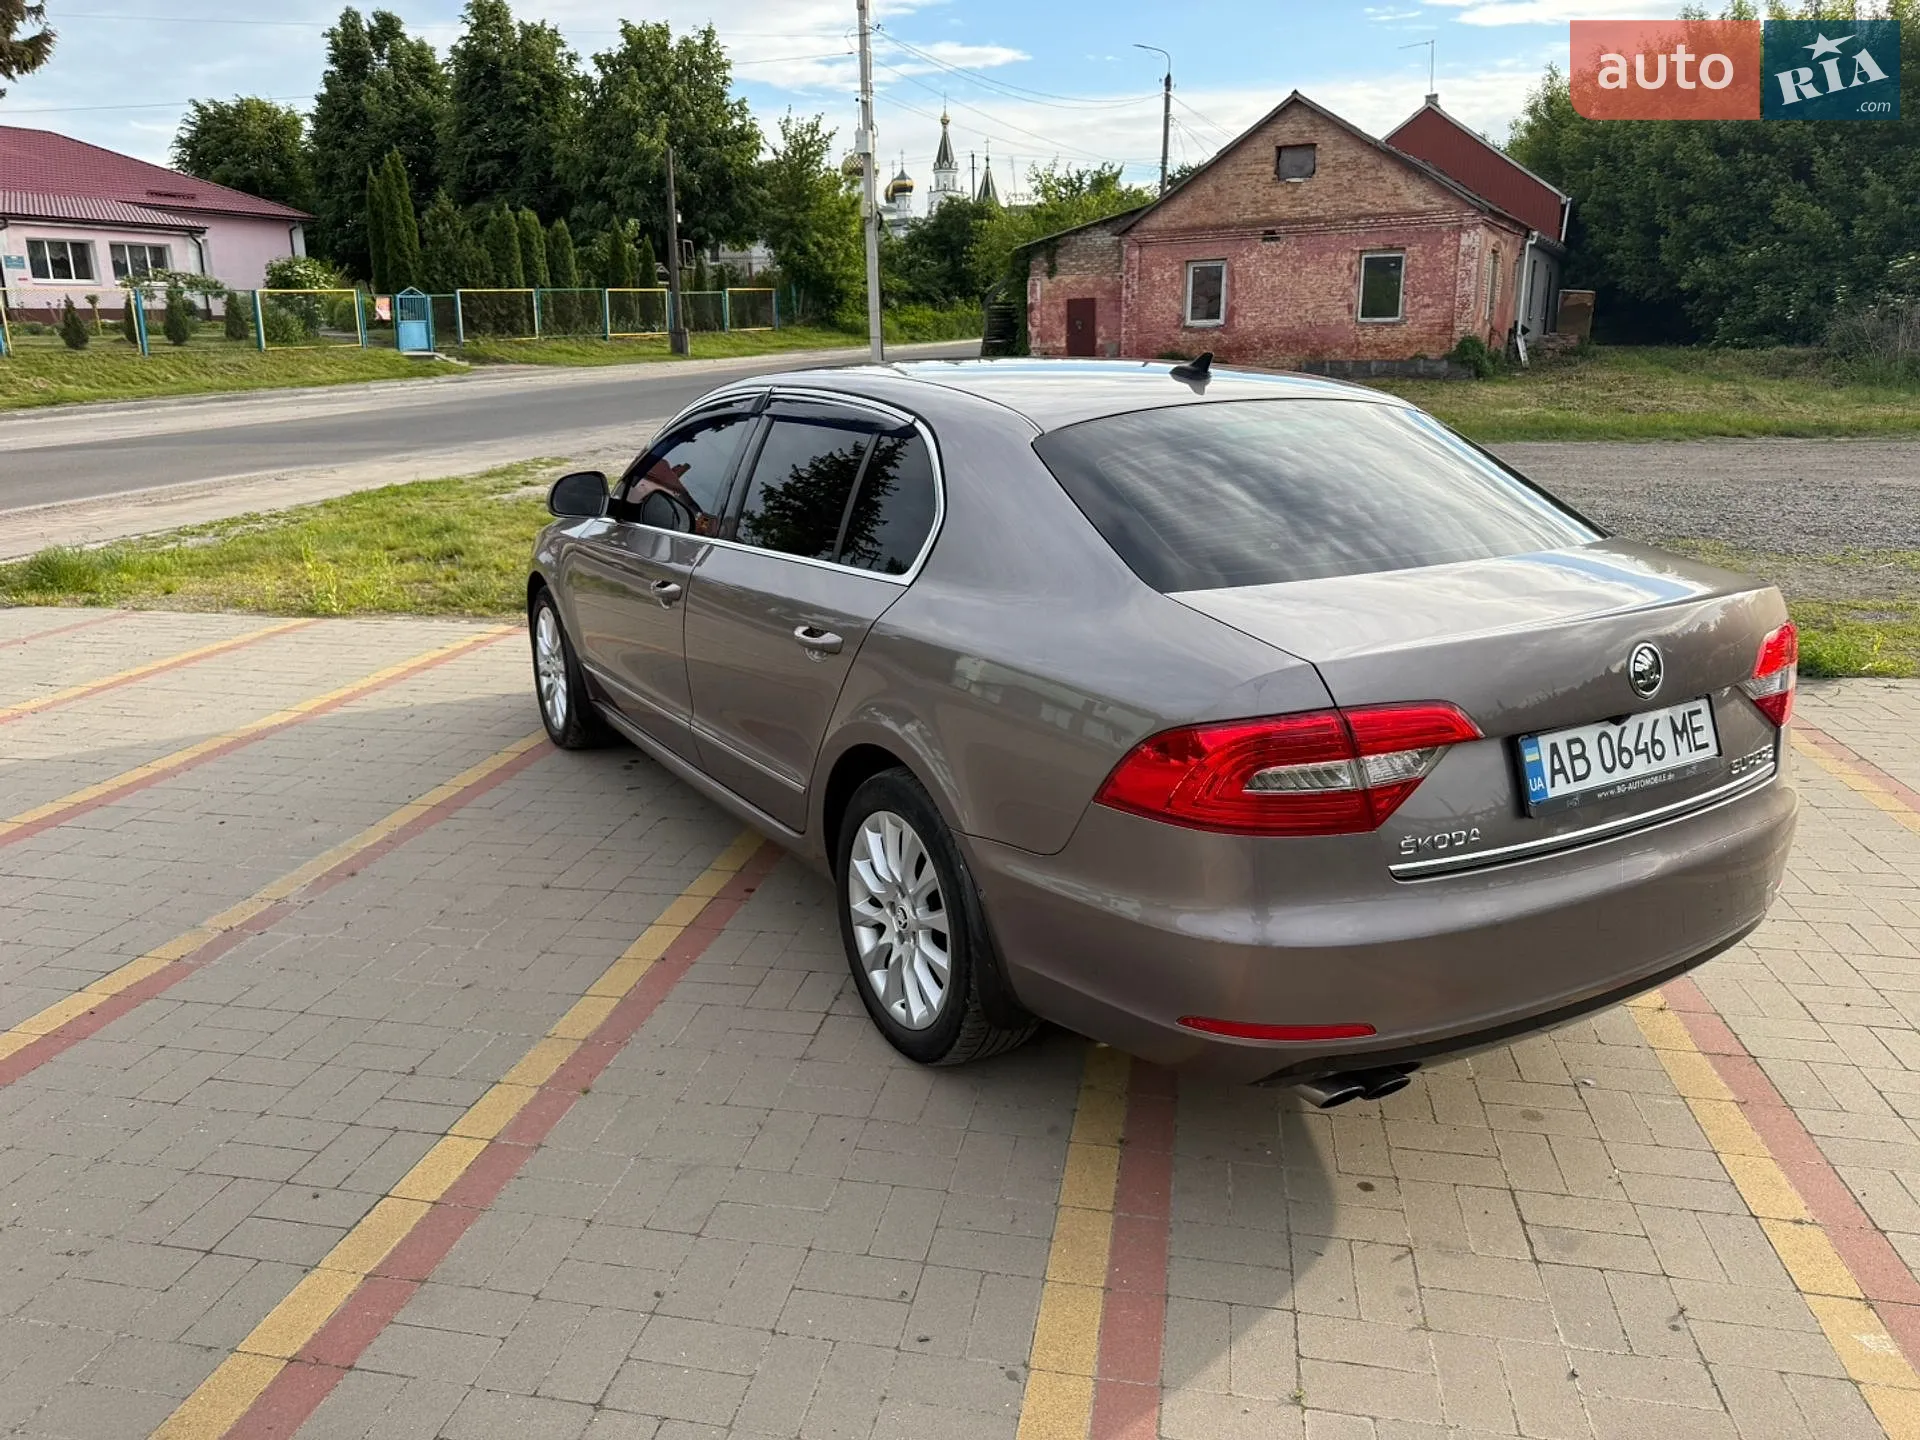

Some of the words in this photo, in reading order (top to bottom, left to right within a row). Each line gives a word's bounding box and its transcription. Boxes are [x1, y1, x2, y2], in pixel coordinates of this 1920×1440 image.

[1550, 737, 1592, 788] AB
[1598, 718, 1666, 774] 0646
[1669, 708, 1710, 757] ME
[1529, 778, 1546, 792] UA
[1400, 828, 1480, 855] ŠKODA
